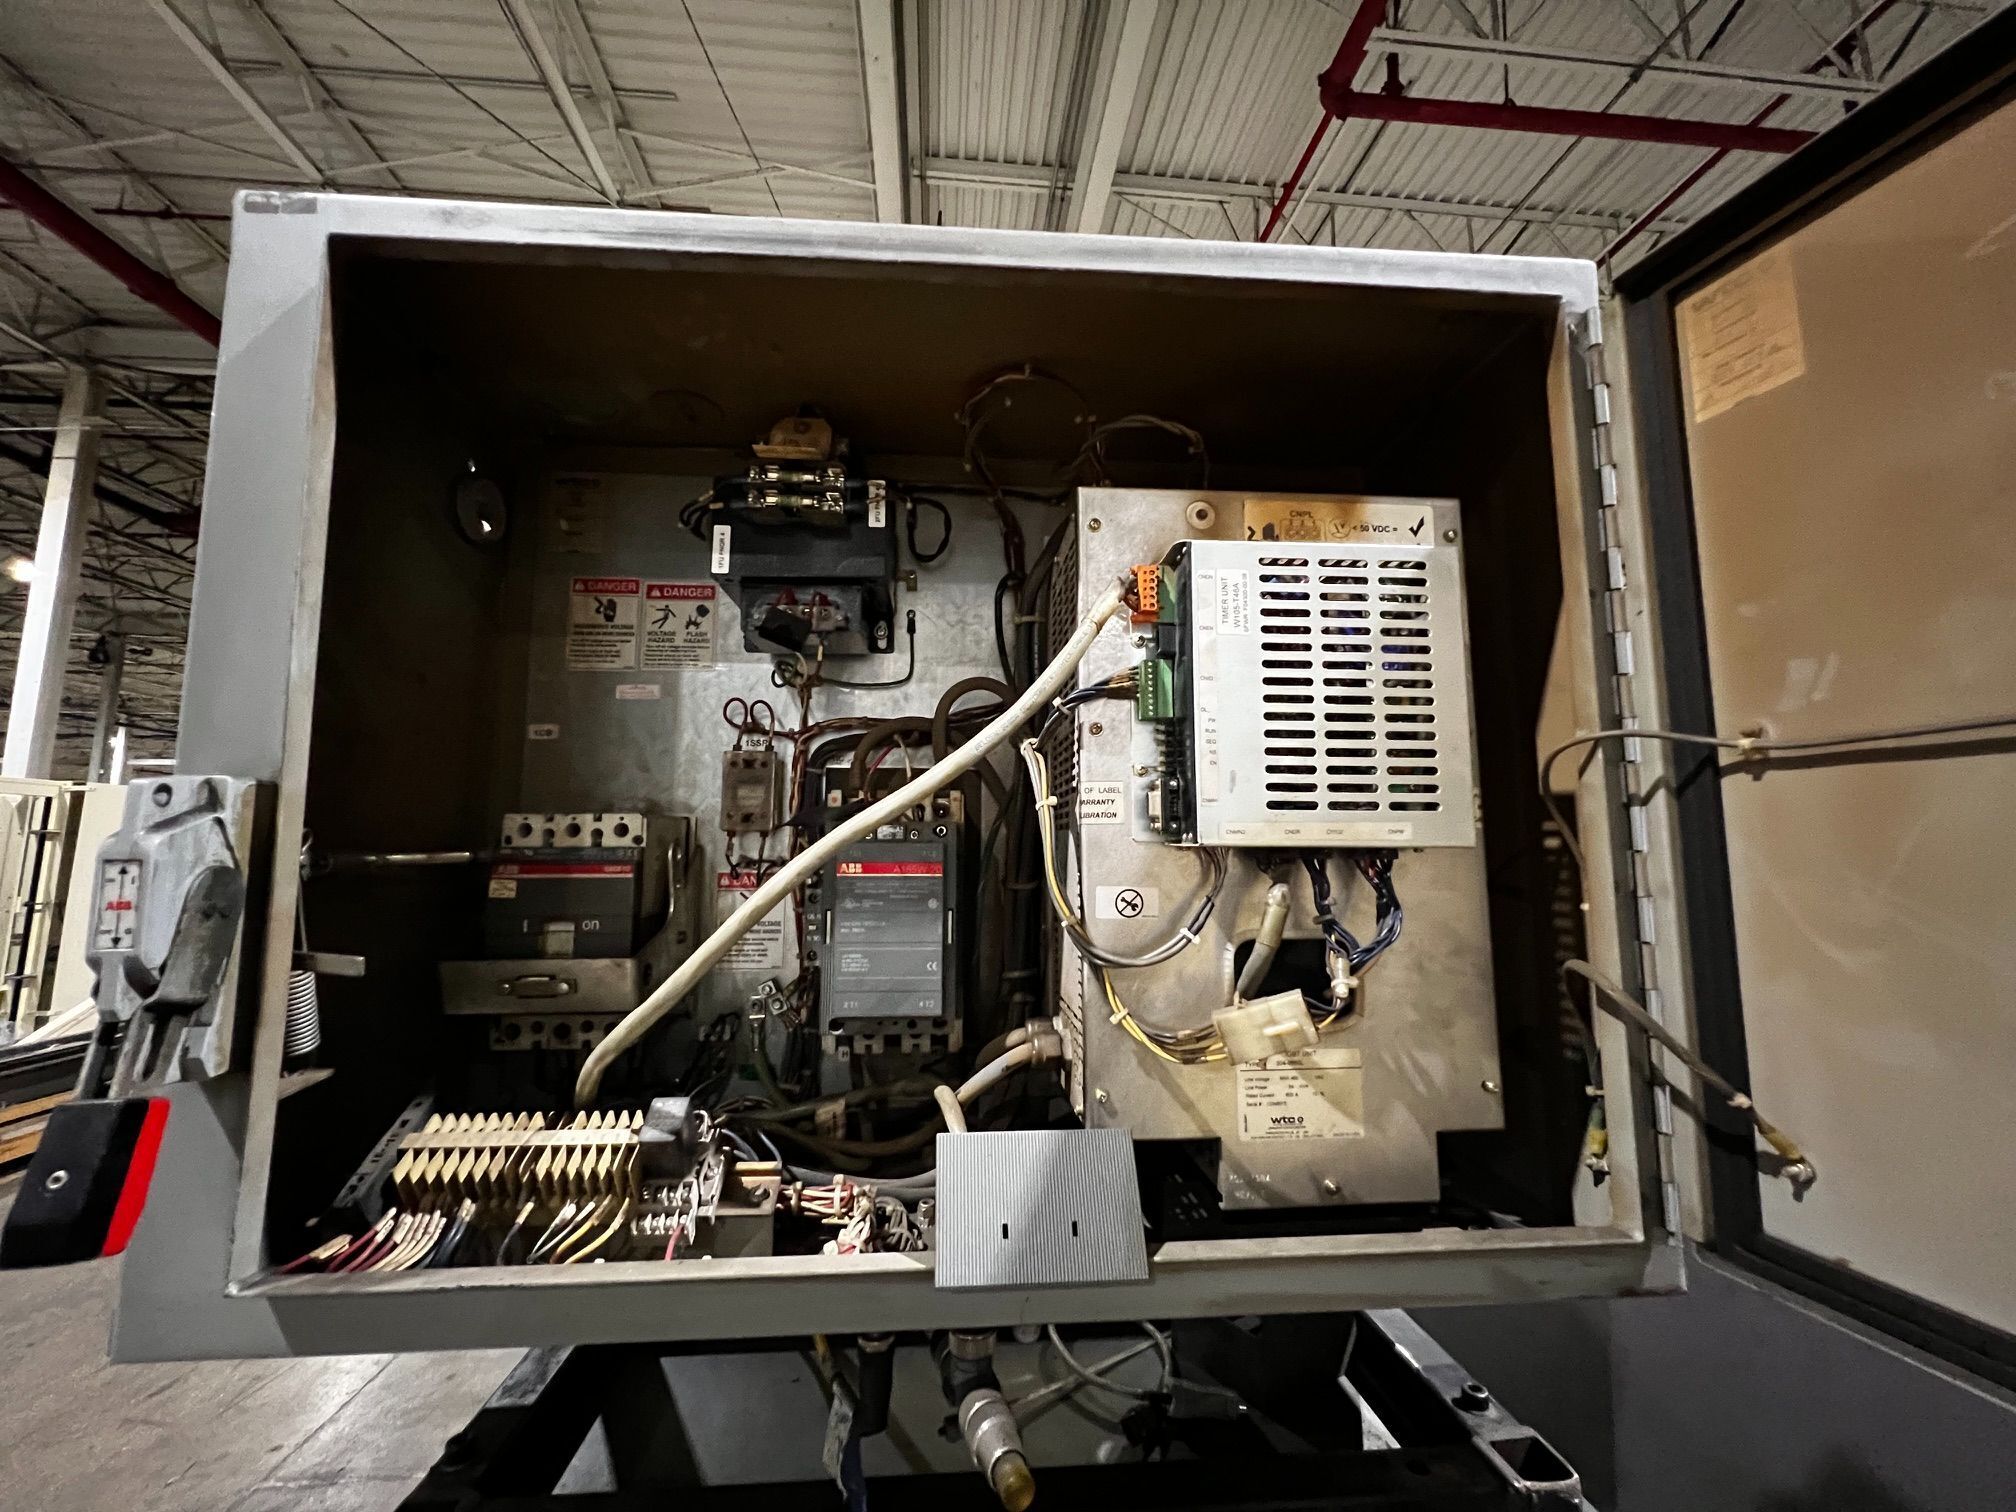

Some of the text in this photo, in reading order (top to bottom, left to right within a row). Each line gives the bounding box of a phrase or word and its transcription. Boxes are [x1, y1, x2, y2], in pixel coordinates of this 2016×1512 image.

[1373, 524, 1390, 533] VDC
[587, 582, 637, 592] DANGER
[663, 587, 713, 597] DANGER
[1220, 577, 1229, 624] TIMER UNIT
[1098, 786, 1122, 794] LABEL
[1080, 798, 1116, 806] ARRANTY
[840, 863, 863, 873] ABB
[581, 920, 600, 931] on
